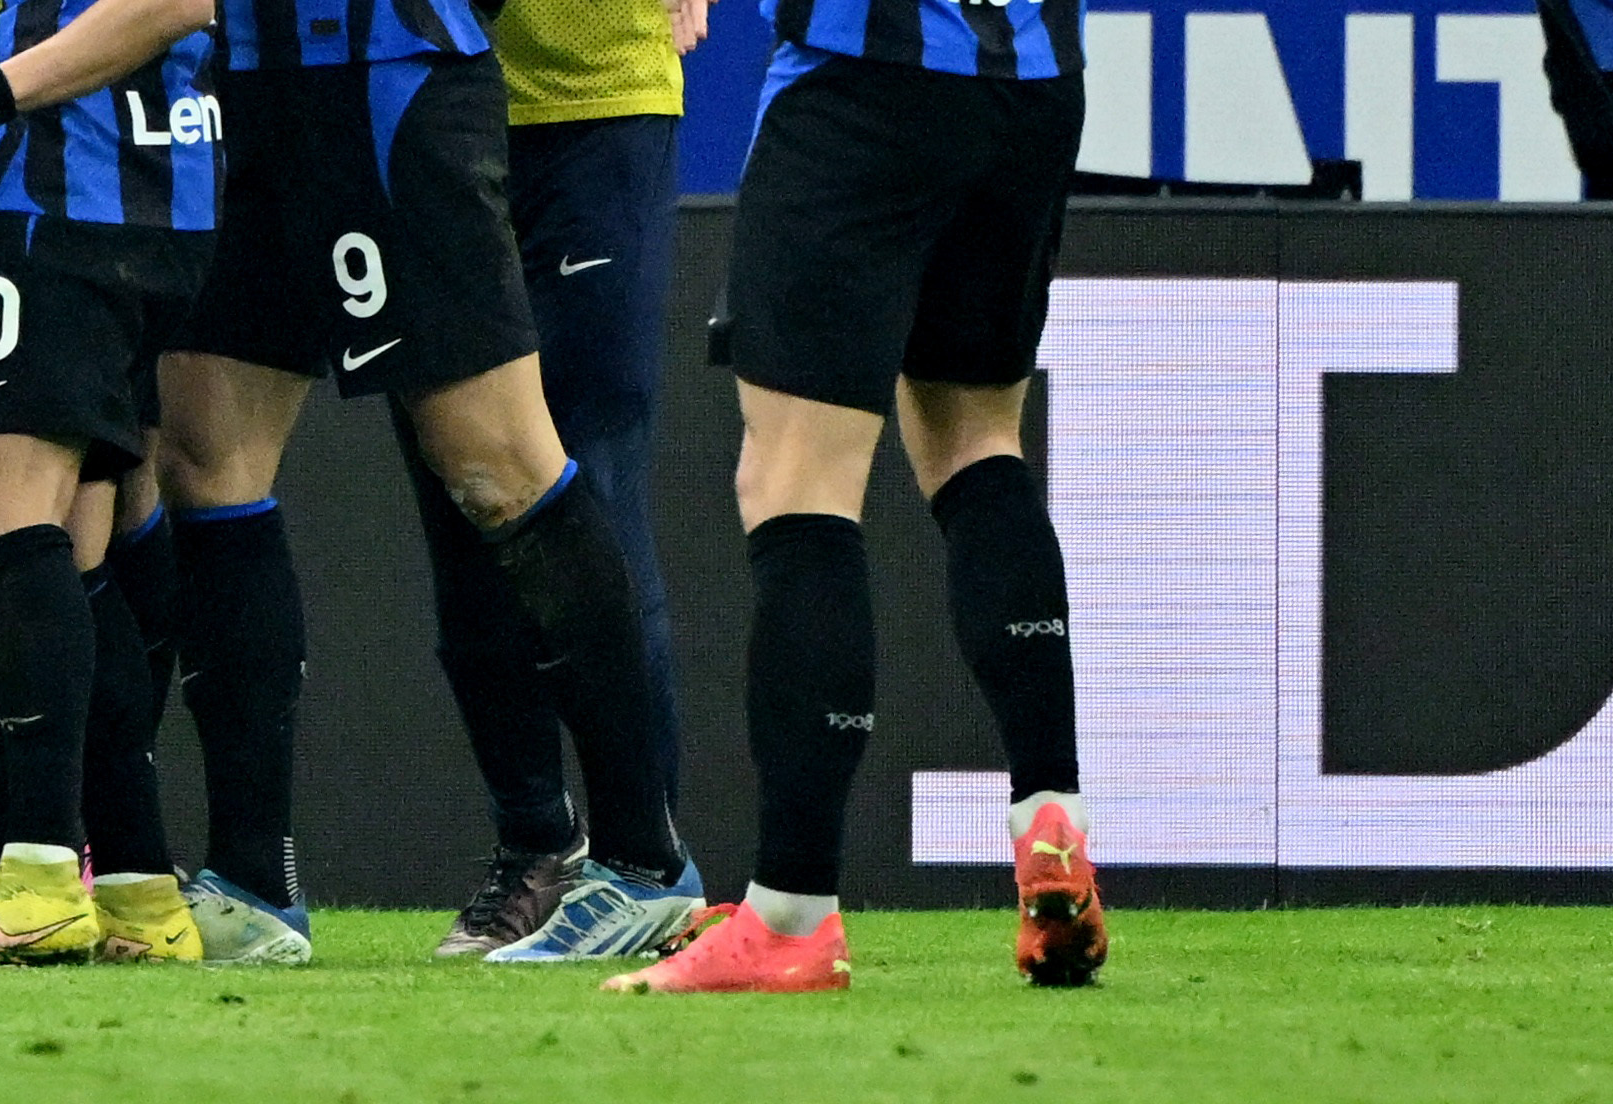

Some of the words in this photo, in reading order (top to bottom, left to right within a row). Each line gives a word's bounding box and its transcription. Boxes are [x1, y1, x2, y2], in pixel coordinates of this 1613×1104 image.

[332, 232, 388, 318] 9
[1005, 618, 1065, 638] 1908
[825, 712, 875, 732] 1908
